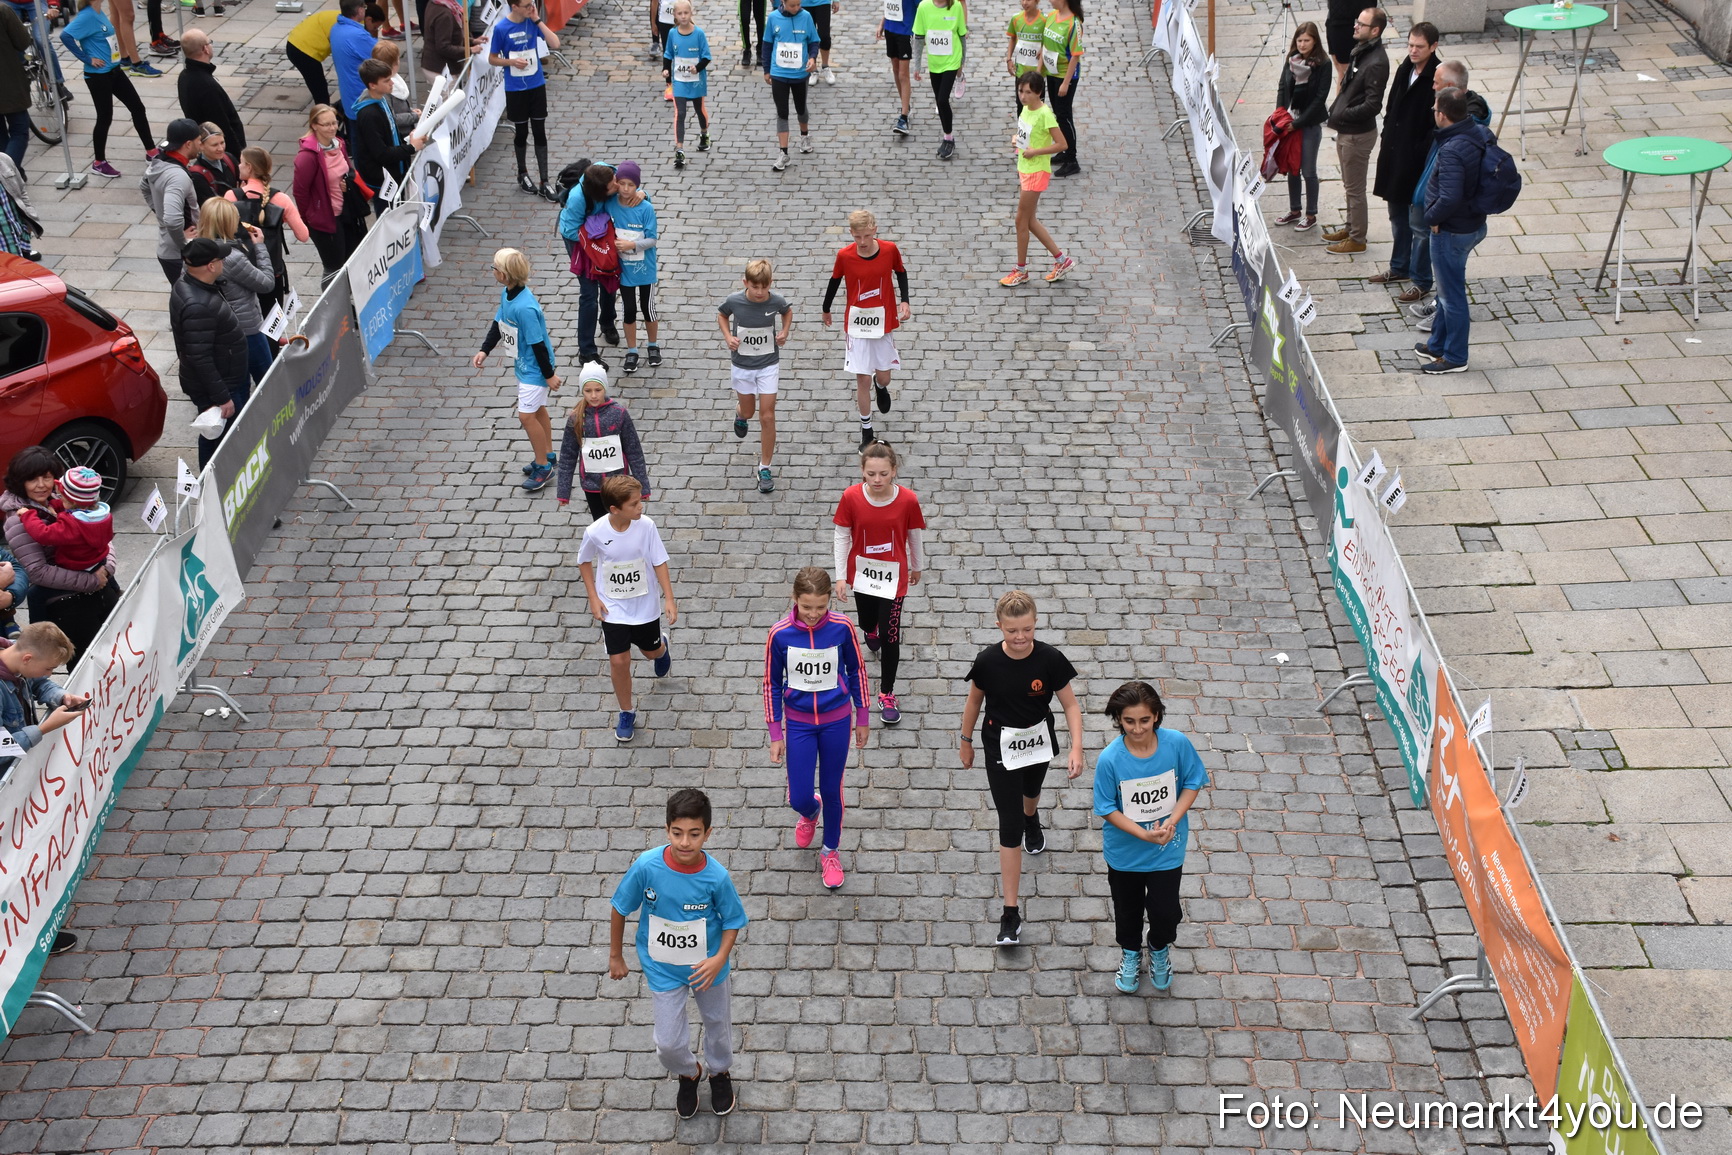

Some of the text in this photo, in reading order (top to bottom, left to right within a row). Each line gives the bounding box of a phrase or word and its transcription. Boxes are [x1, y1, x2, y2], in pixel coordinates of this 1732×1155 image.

[780, 50, 798, 58] 4015
[1019, 48, 1037, 57] 4039
[1249, 180, 1261, 196] swn
[367, 228, 411, 290] RAILONE
[1284, 287, 1294, 300] sw
[1299, 303, 1314, 320] swn
[268, 317, 280, 334] swn
[853, 316, 880, 326] 4000
[500, 330, 515, 345] 030
[743, 335, 768, 345] 4001
[588, 446, 616, 460] 4042
[223, 432, 270, 531] BOCK
[1385, 486, 1401, 506] swn
[146, 505, 158, 523] swn
[609, 570, 641, 585] 4045
[862, 567, 893, 583] 4014
[795, 661, 831, 675] 4019
[1008, 734, 1045, 751] 4044
[1130, 786, 1169, 805] 4028
[1480, 855, 1489, 869] für
[1487, 870, 1496, 884] die
[1490, 850, 1513, 897] Neumarkts
[656, 931, 698, 949] 4033
